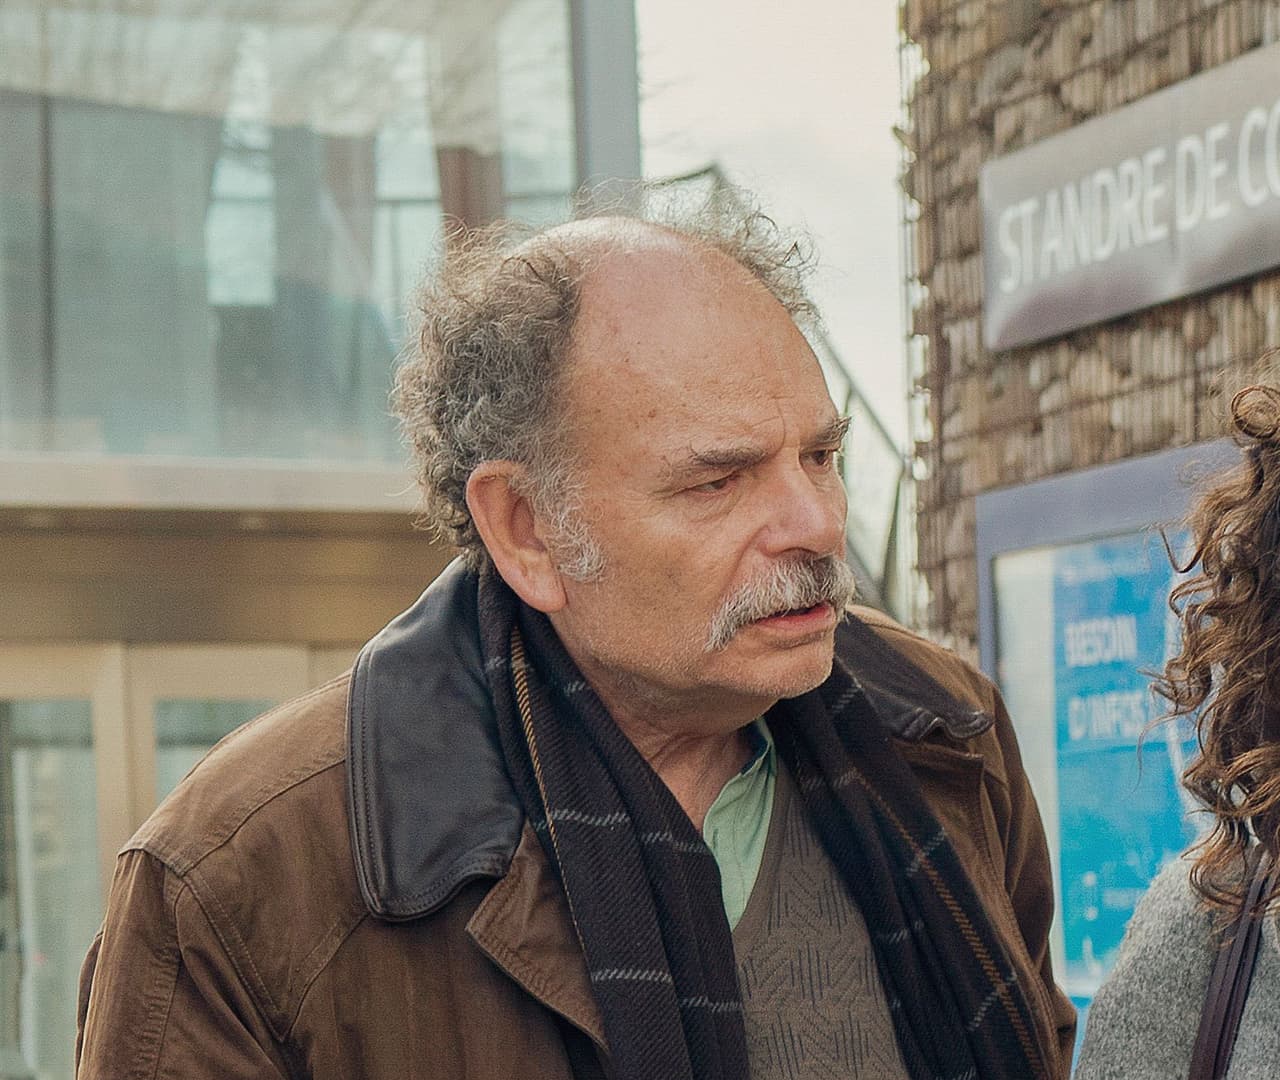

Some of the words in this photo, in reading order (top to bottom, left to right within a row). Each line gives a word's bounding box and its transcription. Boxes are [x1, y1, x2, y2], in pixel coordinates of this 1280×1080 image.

[1000, 197, 1039, 292] ST
[1039, 148, 1169, 279] ANDRE
[1175, 122, 1231, 232] DE
